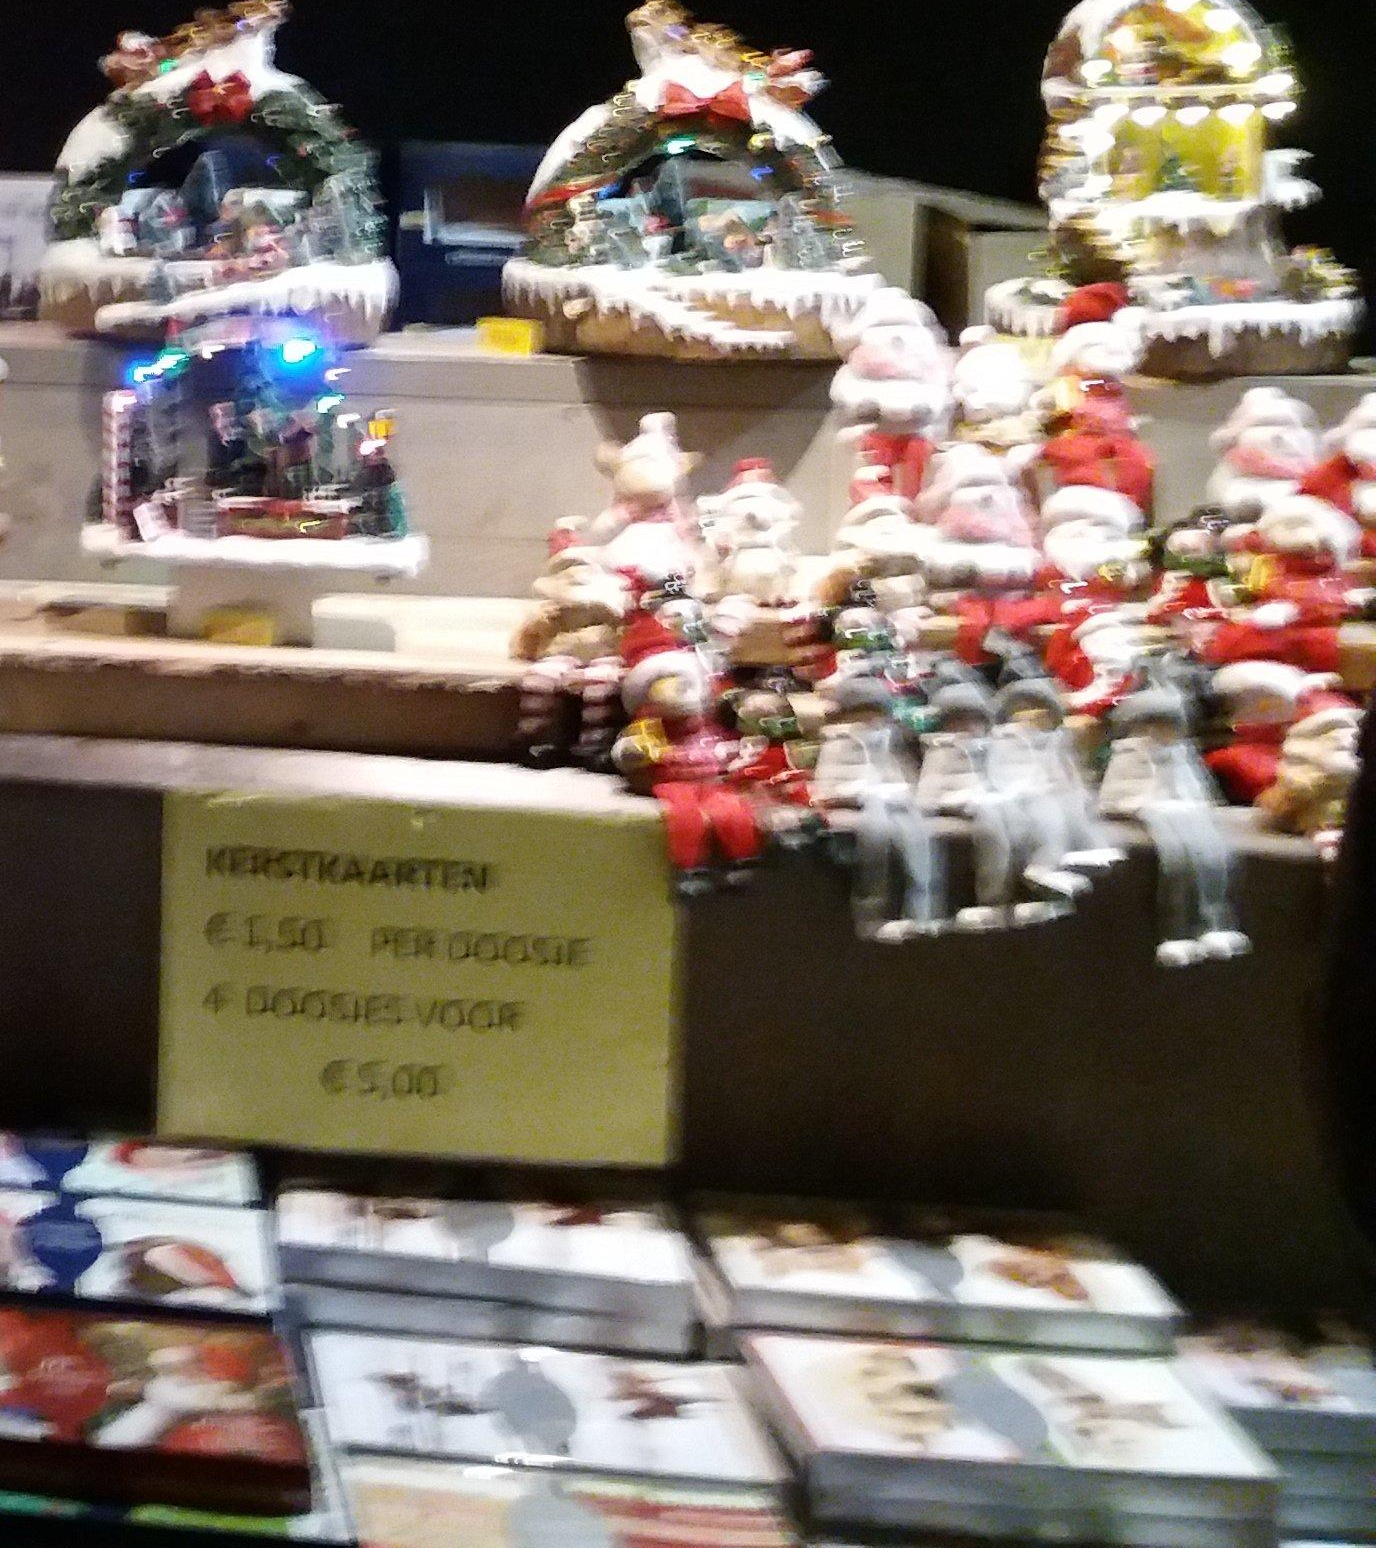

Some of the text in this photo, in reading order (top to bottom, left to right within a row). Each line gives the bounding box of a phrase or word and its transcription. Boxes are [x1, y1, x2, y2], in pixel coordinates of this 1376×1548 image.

[206, 846, 494, 893] KERSTKAARTEN
[371, 927, 438, 959] PER
[416, 999, 523, 1032] VOOR
